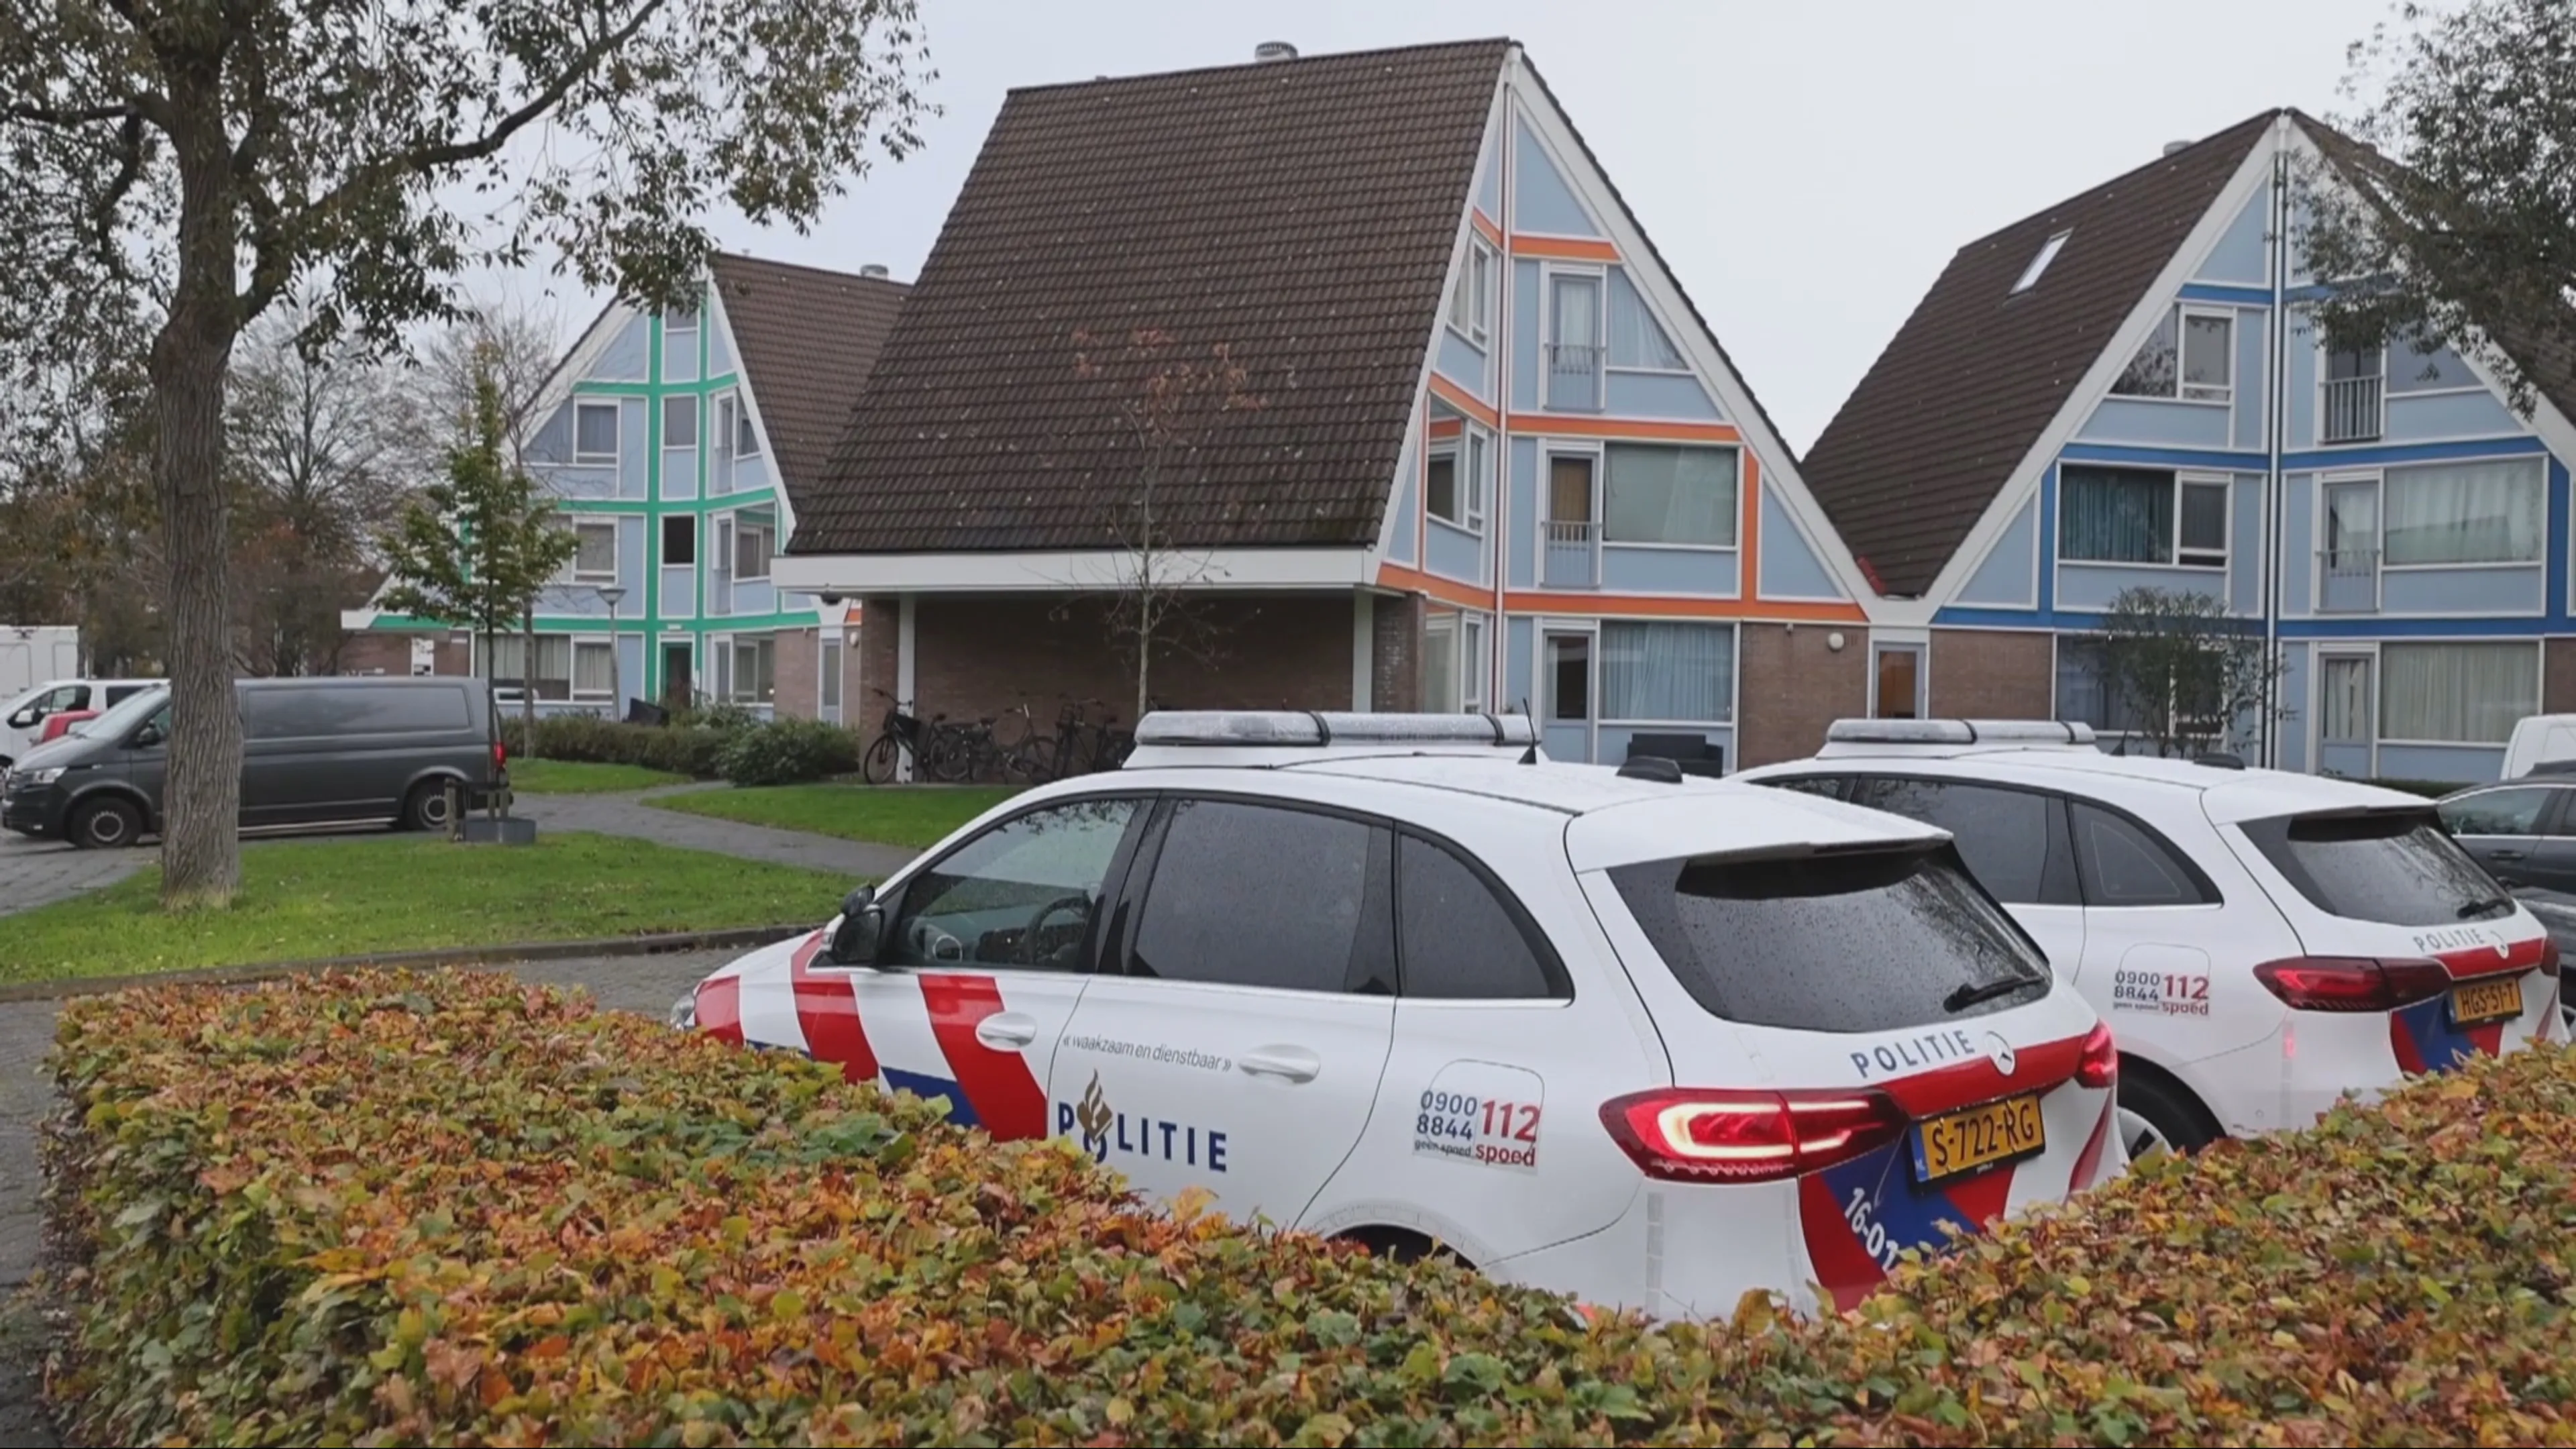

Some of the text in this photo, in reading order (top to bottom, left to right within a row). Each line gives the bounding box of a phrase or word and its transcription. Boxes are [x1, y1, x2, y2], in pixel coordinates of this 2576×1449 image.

[2413, 928, 2484, 952] POLITIE
[2115, 971, 2160, 986] 0900
[2164, 975, 2209, 1000] 112
[2114, 985, 2159, 1002] 8844
[2162, 1002, 2208, 1016] spoed
[1073, 1034, 1134, 1057] waakzaam
[1135, 1044, 1150, 1059] en
[1152, 1044, 1221, 1071] dienstbaar
[1850, 1030, 1976, 1079] POLITIE
[1420, 1090, 1477, 1117] 0900
[1416, 1114, 1472, 1140] 8844
[1482, 1100, 1540, 1143] 112
[1932, 1103, 2035, 1167] S-722-RG
[1476, 1143, 1536, 1167] spoed
